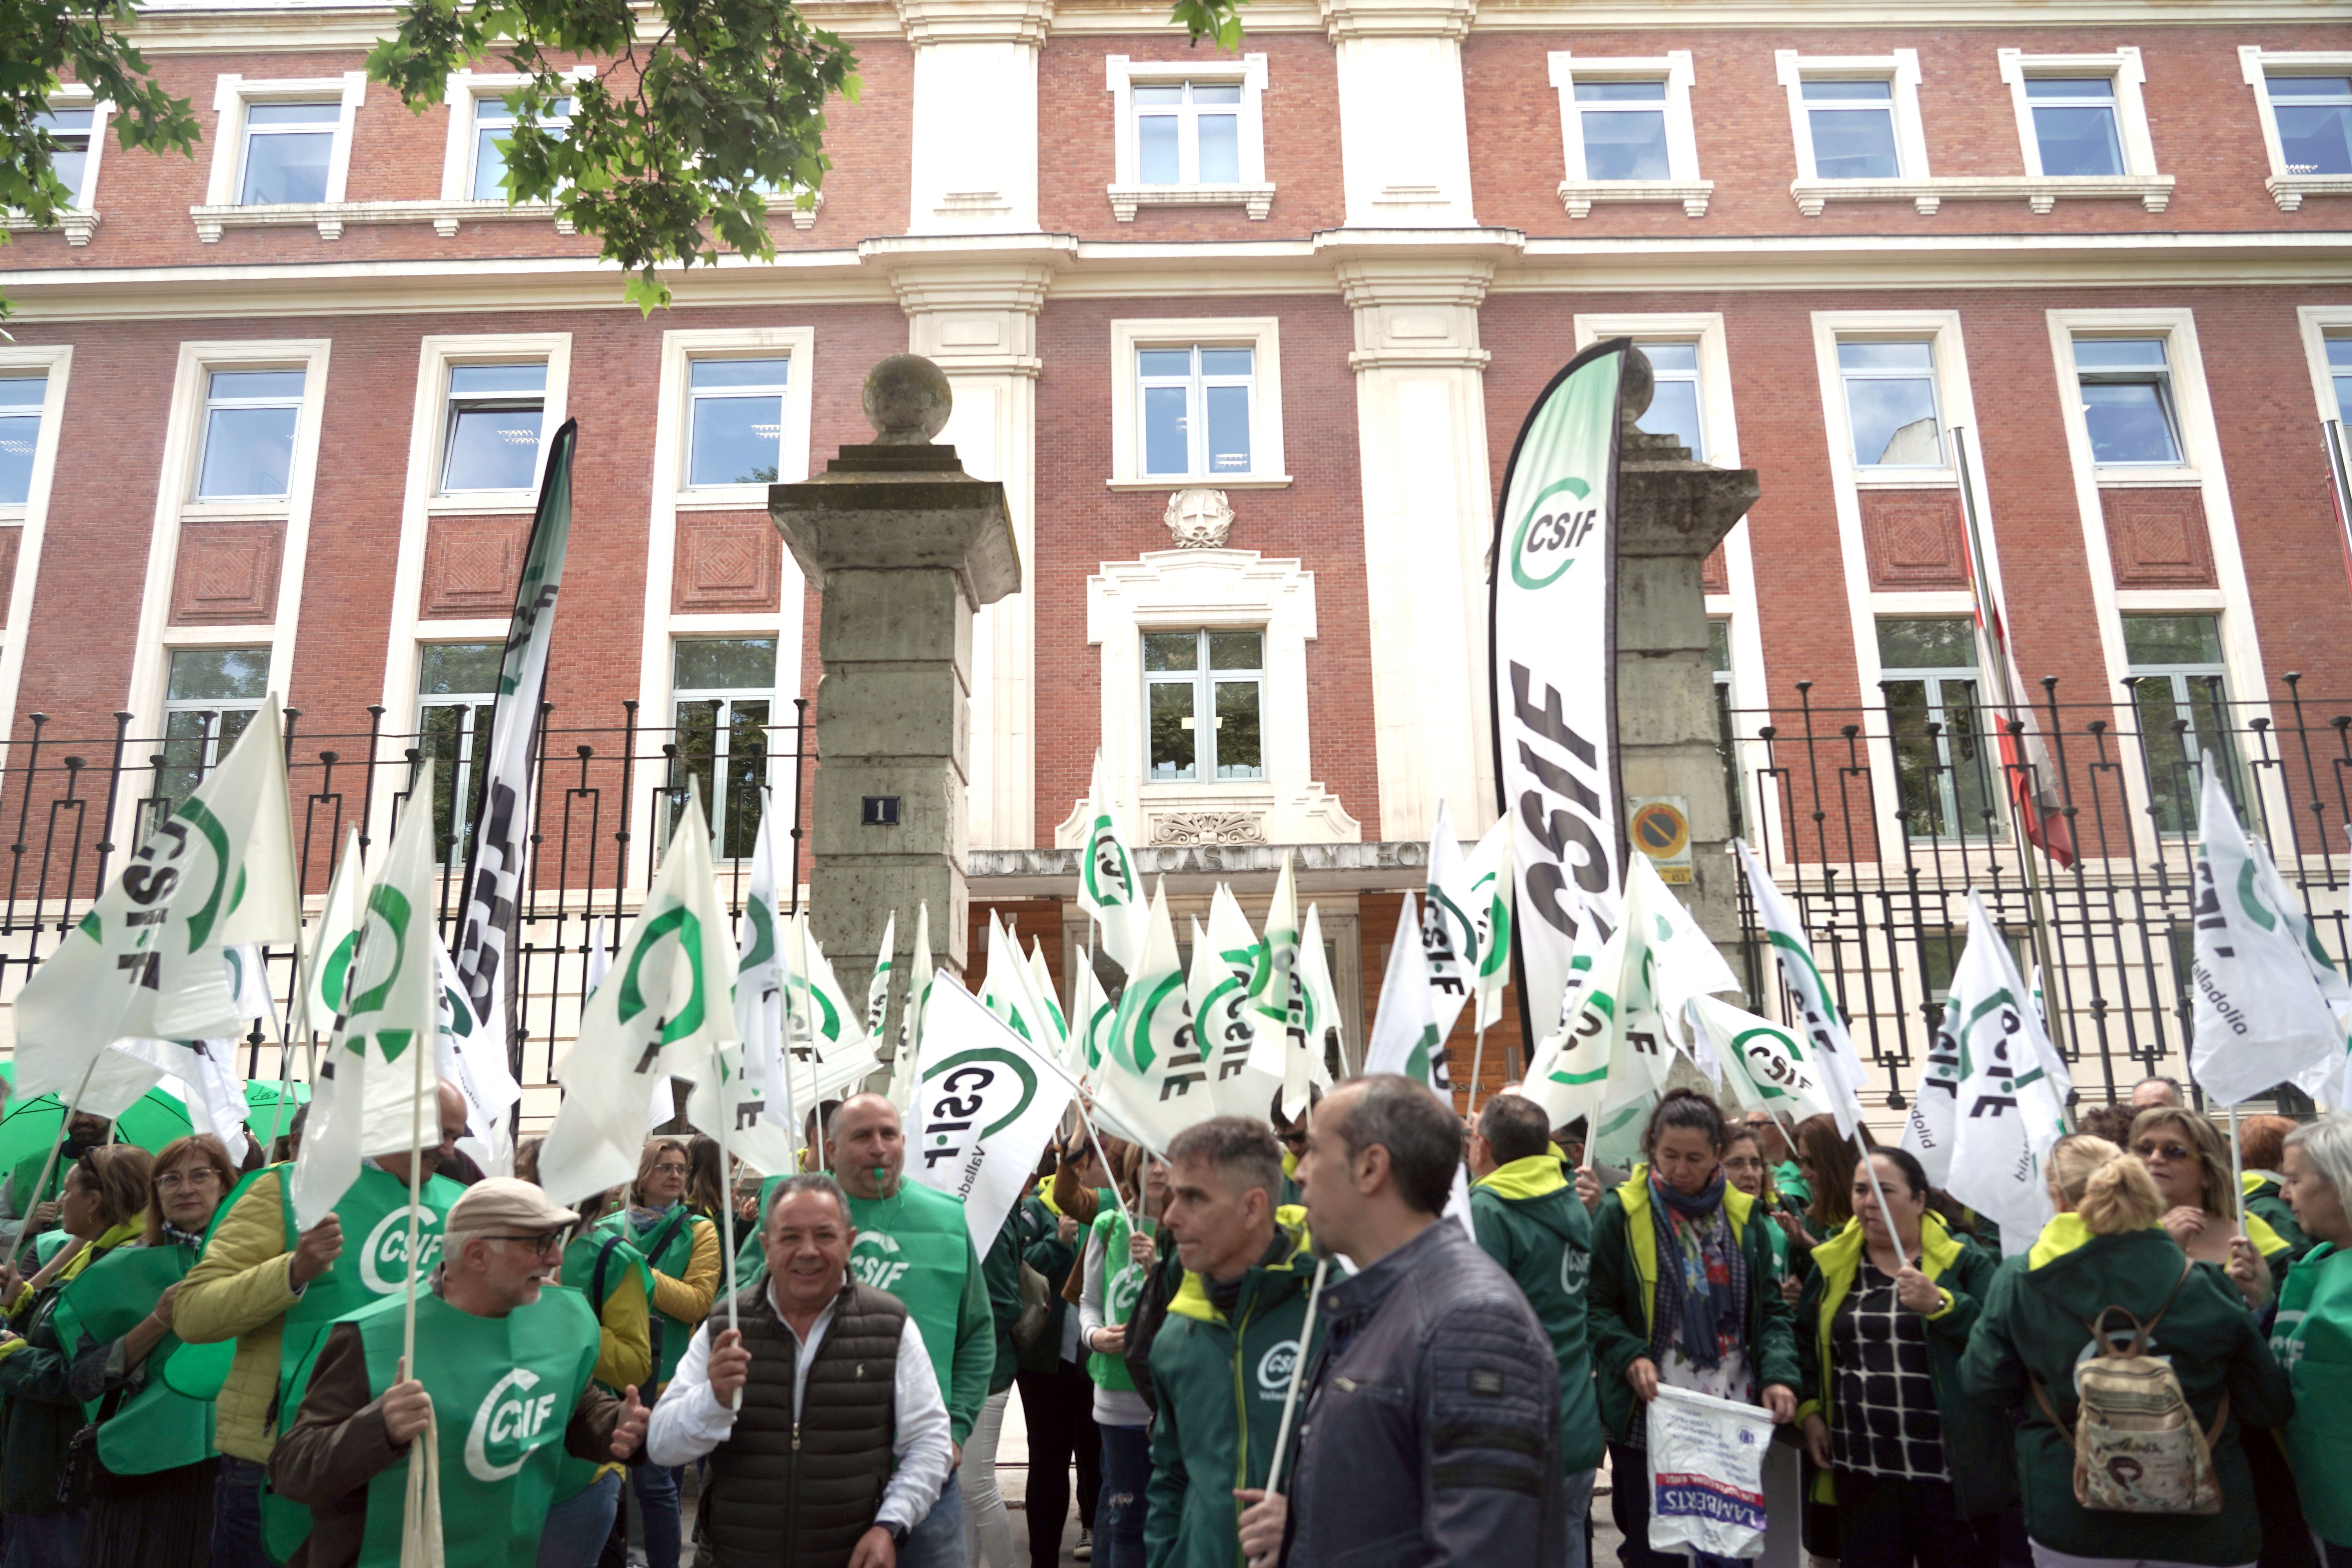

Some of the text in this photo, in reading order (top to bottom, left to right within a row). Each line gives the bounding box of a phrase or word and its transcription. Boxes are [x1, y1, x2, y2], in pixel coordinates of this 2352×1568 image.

[1527, 509, 1597, 553] CSIF
[876, 800, 885, 821] 1
[1267, 1354, 1298, 1374] CSI
[1664, 1490, 1758, 1526] LAMBERTS
